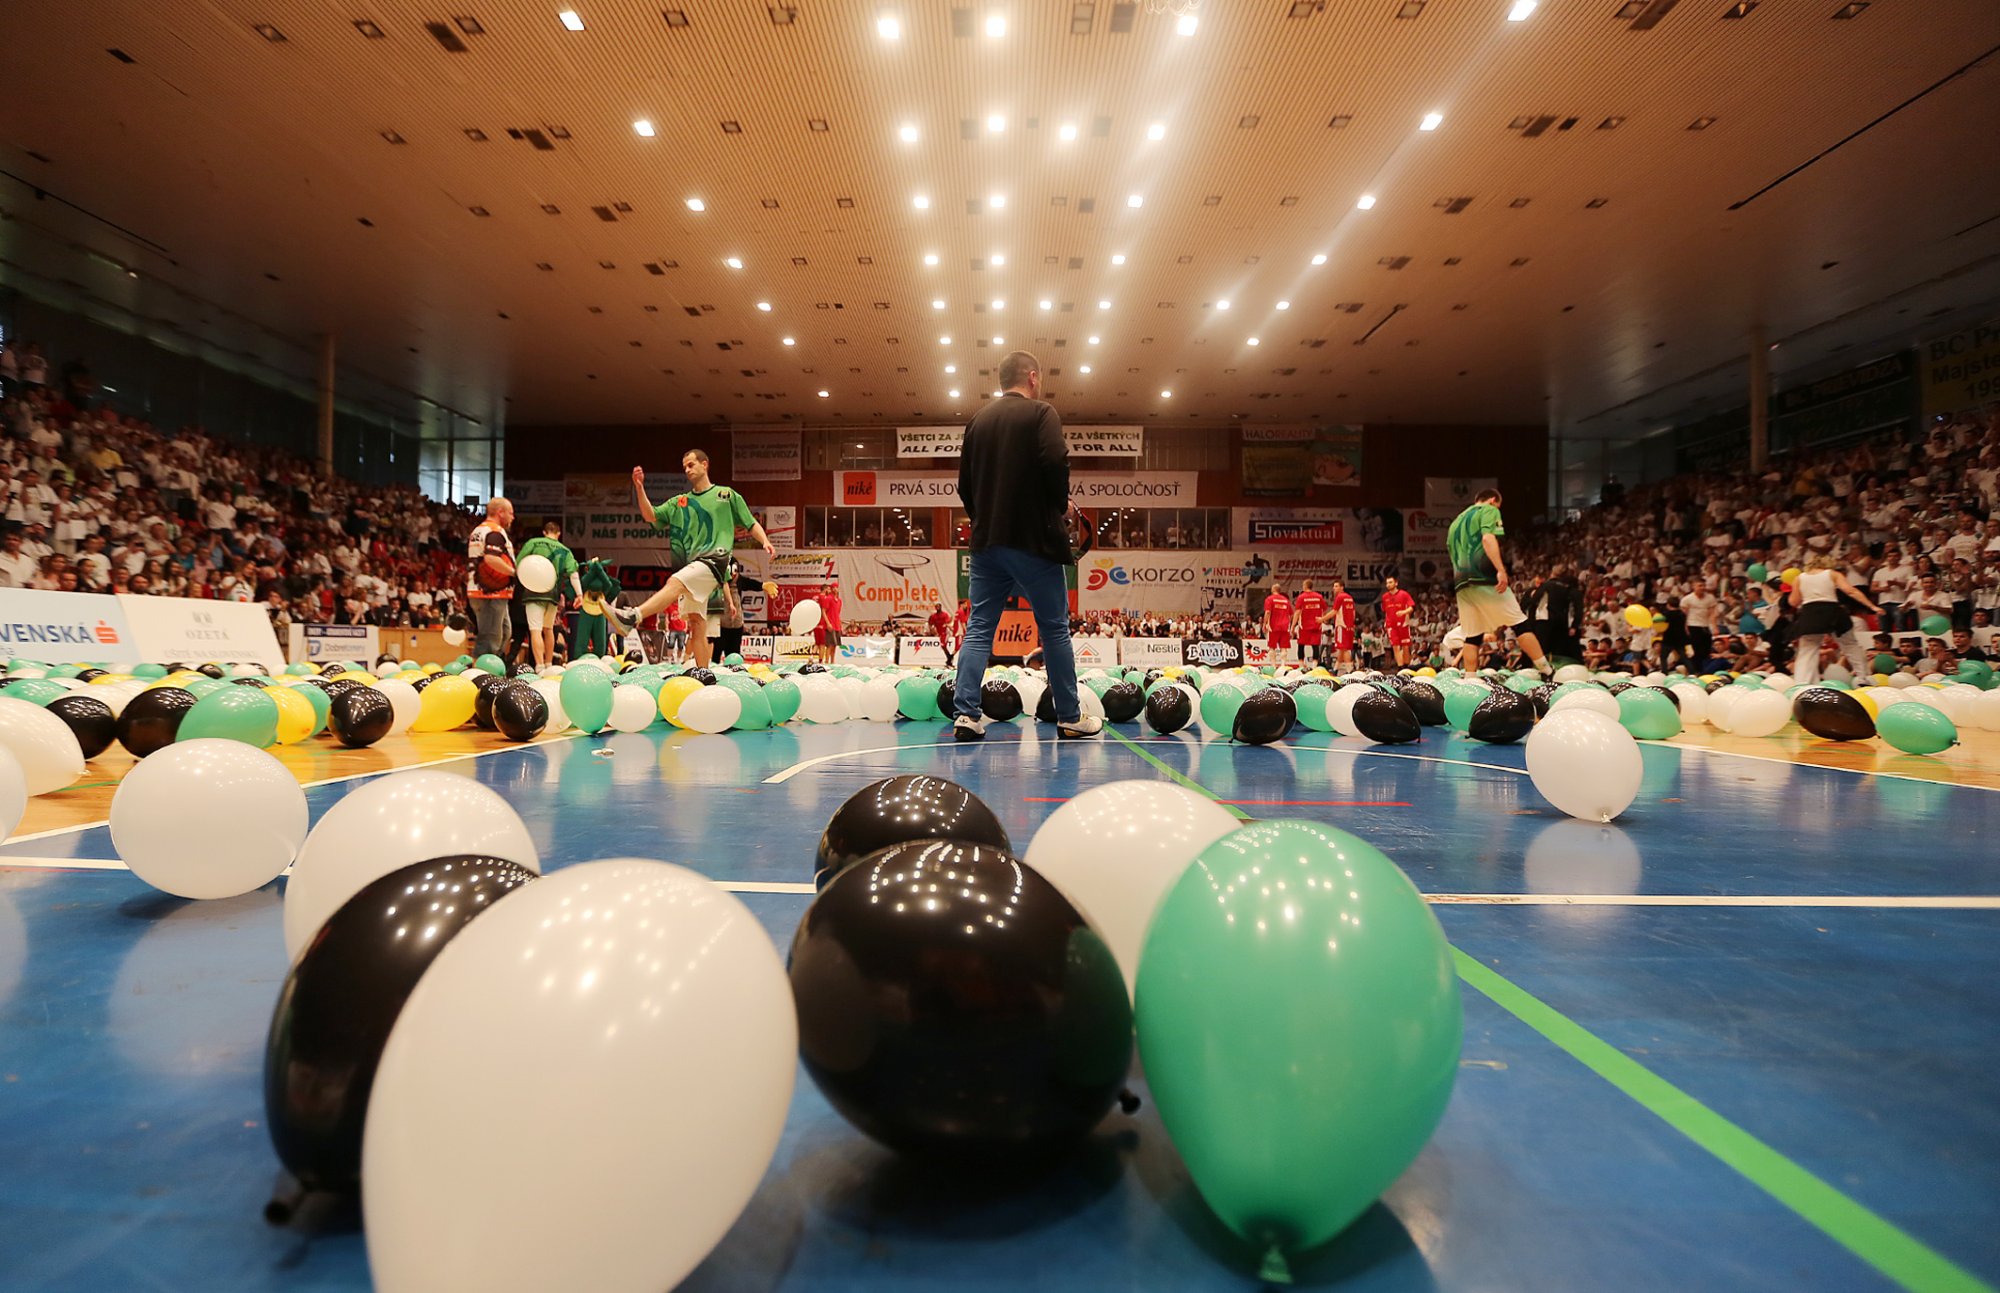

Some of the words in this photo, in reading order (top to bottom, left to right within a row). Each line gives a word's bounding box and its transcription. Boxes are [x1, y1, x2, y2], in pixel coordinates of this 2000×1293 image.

[900, 432, 936, 442] VŠETCI
[939, 433, 952, 442] ZA
[1070, 432, 1083, 440] ZA
[1087, 430, 1140, 441] VŠETKÝCH
[902, 445, 930, 453] ALL
[1073, 444, 1105, 452] FOR
[1109, 444, 1138, 452] ALL
[847, 481, 873, 496] niké
[890, 480, 924, 496] PRVÁ
[1090, 481, 1181, 496] SPOLOČNOSŤ
[591, 514, 628, 524] MESTO
[592, 526, 616, 538] NÁS
[1255, 522, 1336, 539] Slovaktual
[855, 579, 939, 612] Complete
[1214, 588, 1245, 599] BVH
[998, 623, 1032, 642] niké
[907, 640, 954, 648] REVMOT
